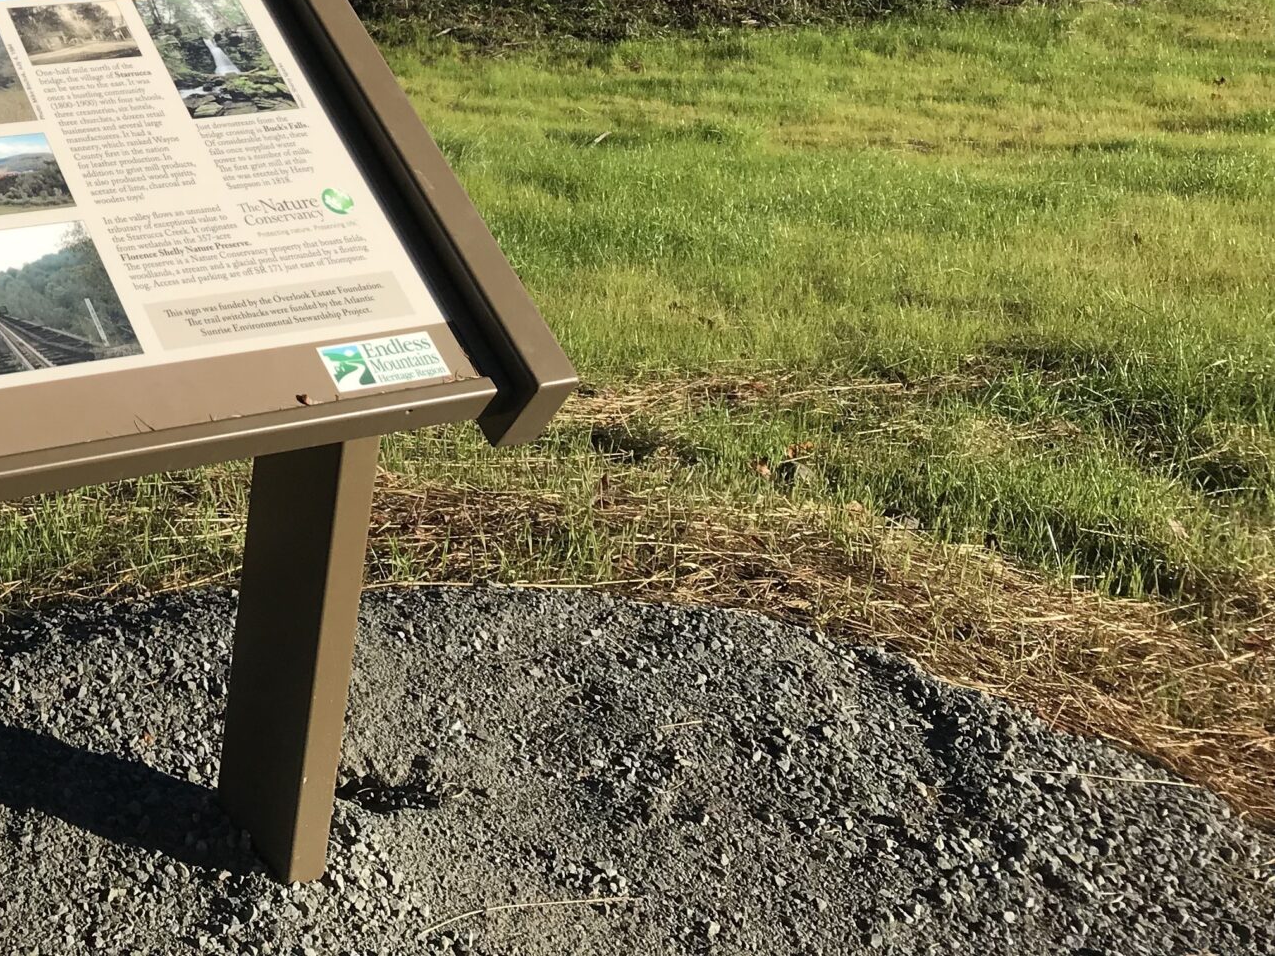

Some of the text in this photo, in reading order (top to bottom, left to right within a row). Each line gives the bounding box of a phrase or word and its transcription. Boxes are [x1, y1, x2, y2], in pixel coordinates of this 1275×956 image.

[236, 198, 319, 214] The Nature
[243, 206, 324, 226] Conservancy
[119, 241, 252, 262] Florence Shelly Nature Preserve.
[163, 309, 183, 318] This
[184, 308, 202, 317] sign
[218, 299, 248, 311] funded
[246, 299, 258, 308] by
[258, 297, 273, 305] the
[272, 291, 311, 303] Overlook
[310, 289, 337, 298] Estate
[336, 283, 384, 294] Foundation.
[185, 318, 203, 327] The
[203, 314, 221, 324] trail
[221, 309, 270, 322] switchbacks
[289, 301, 318, 312] funded
[316, 300, 328, 310] by
[329, 299, 343, 307] the
[343, 294, 375, 305] Atlantic
[200, 307, 372, 337] Sunrise Environmental Stewardship Project.
[361, 338, 431, 359] Endless
[369, 352, 440, 373] Mountains
